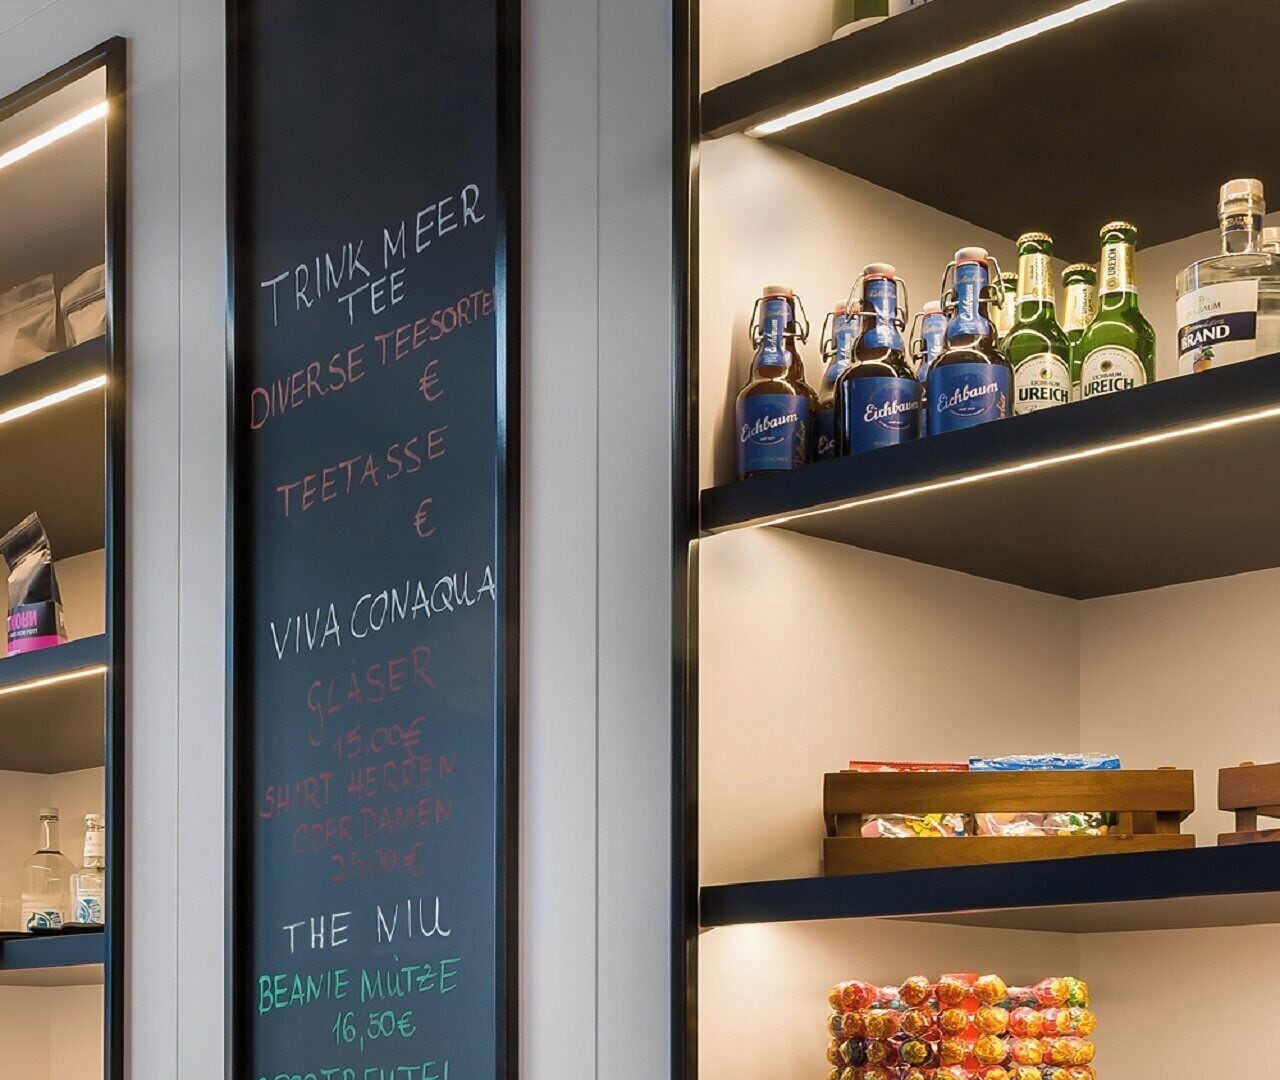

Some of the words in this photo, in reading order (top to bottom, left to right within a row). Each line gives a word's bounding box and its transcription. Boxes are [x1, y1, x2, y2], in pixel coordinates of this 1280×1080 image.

[260, 239, 371, 328] TRINK
[382, 183, 486, 269] MEER
[337, 267, 406, 326] TEE
[1181, 324, 1231, 351] BRAND
[249, 343, 366, 431] DIVERSE
[418, 358, 445, 402] €
[935, 380, 1000, 413] Eichbaum
[1018, 387, 1070, 404] UREICH
[1083, 377, 1135, 398] UREICH
[740, 411, 799, 444] Eichbaum
[863, 399, 919, 423] Eichbaum
[276, 425, 448, 518] TEETASSE
[413, 497, 437, 539] €
[270, 602, 341, 660] VIVA
[350, 565, 496, 639] CONAQUA
[259, 771, 336, 820] SHIRT
[346, 752, 458, 801] HERREN
[358, 797, 454, 838] DAMEN
[282, 911, 353, 953] THE
[376, 895, 452, 944] NIU
[258, 968, 350, 1016] BEANIE
[332, 1010, 417, 1052] 16,50€
